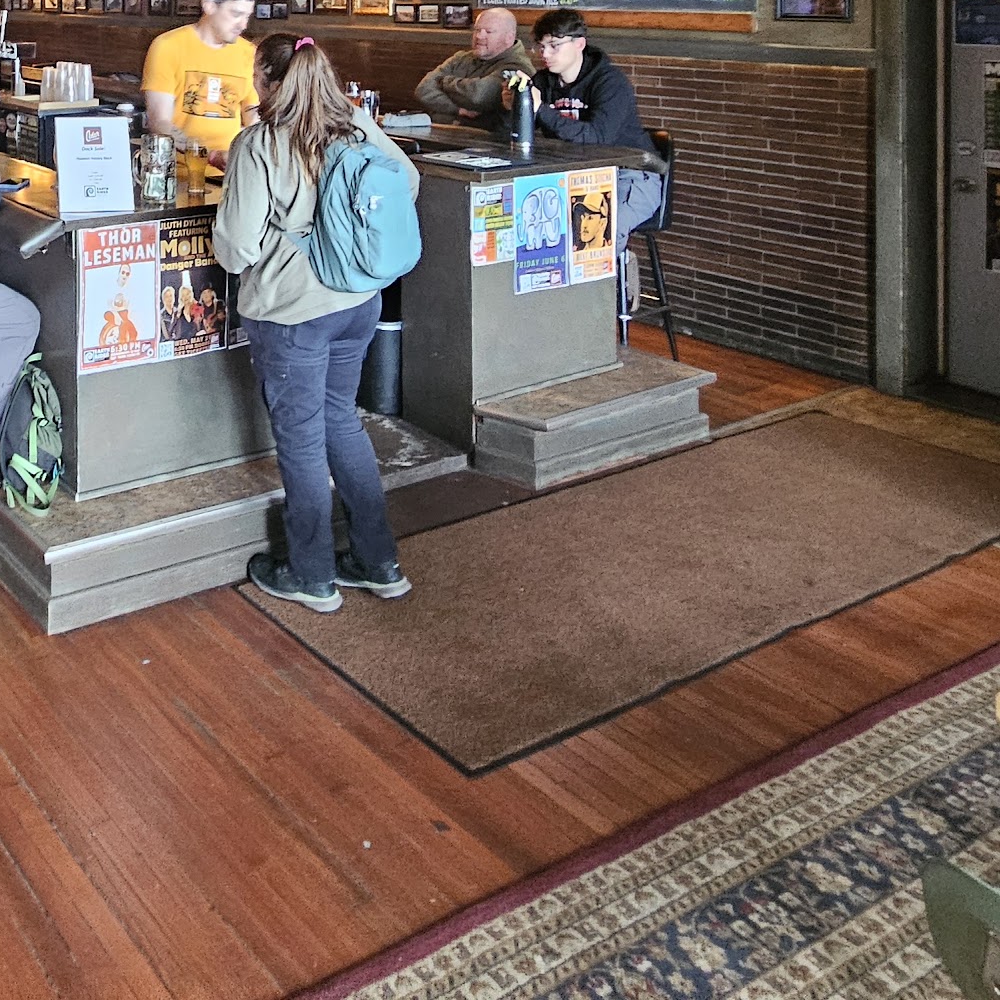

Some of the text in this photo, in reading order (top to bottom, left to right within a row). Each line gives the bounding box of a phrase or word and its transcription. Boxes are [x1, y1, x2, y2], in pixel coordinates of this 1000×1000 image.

[183, 218, 208, 228] DYLAN
[98, 227, 142, 247] THOR
[169, 226, 209, 239] FEATURING
[160, 236, 214, 259] Molly
[84, 243, 156, 267] LESEMAN
[516, 258, 539, 268] FRIDAY
[542, 255, 559, 265] JUNE
[129, 340, 141, 351] PM
